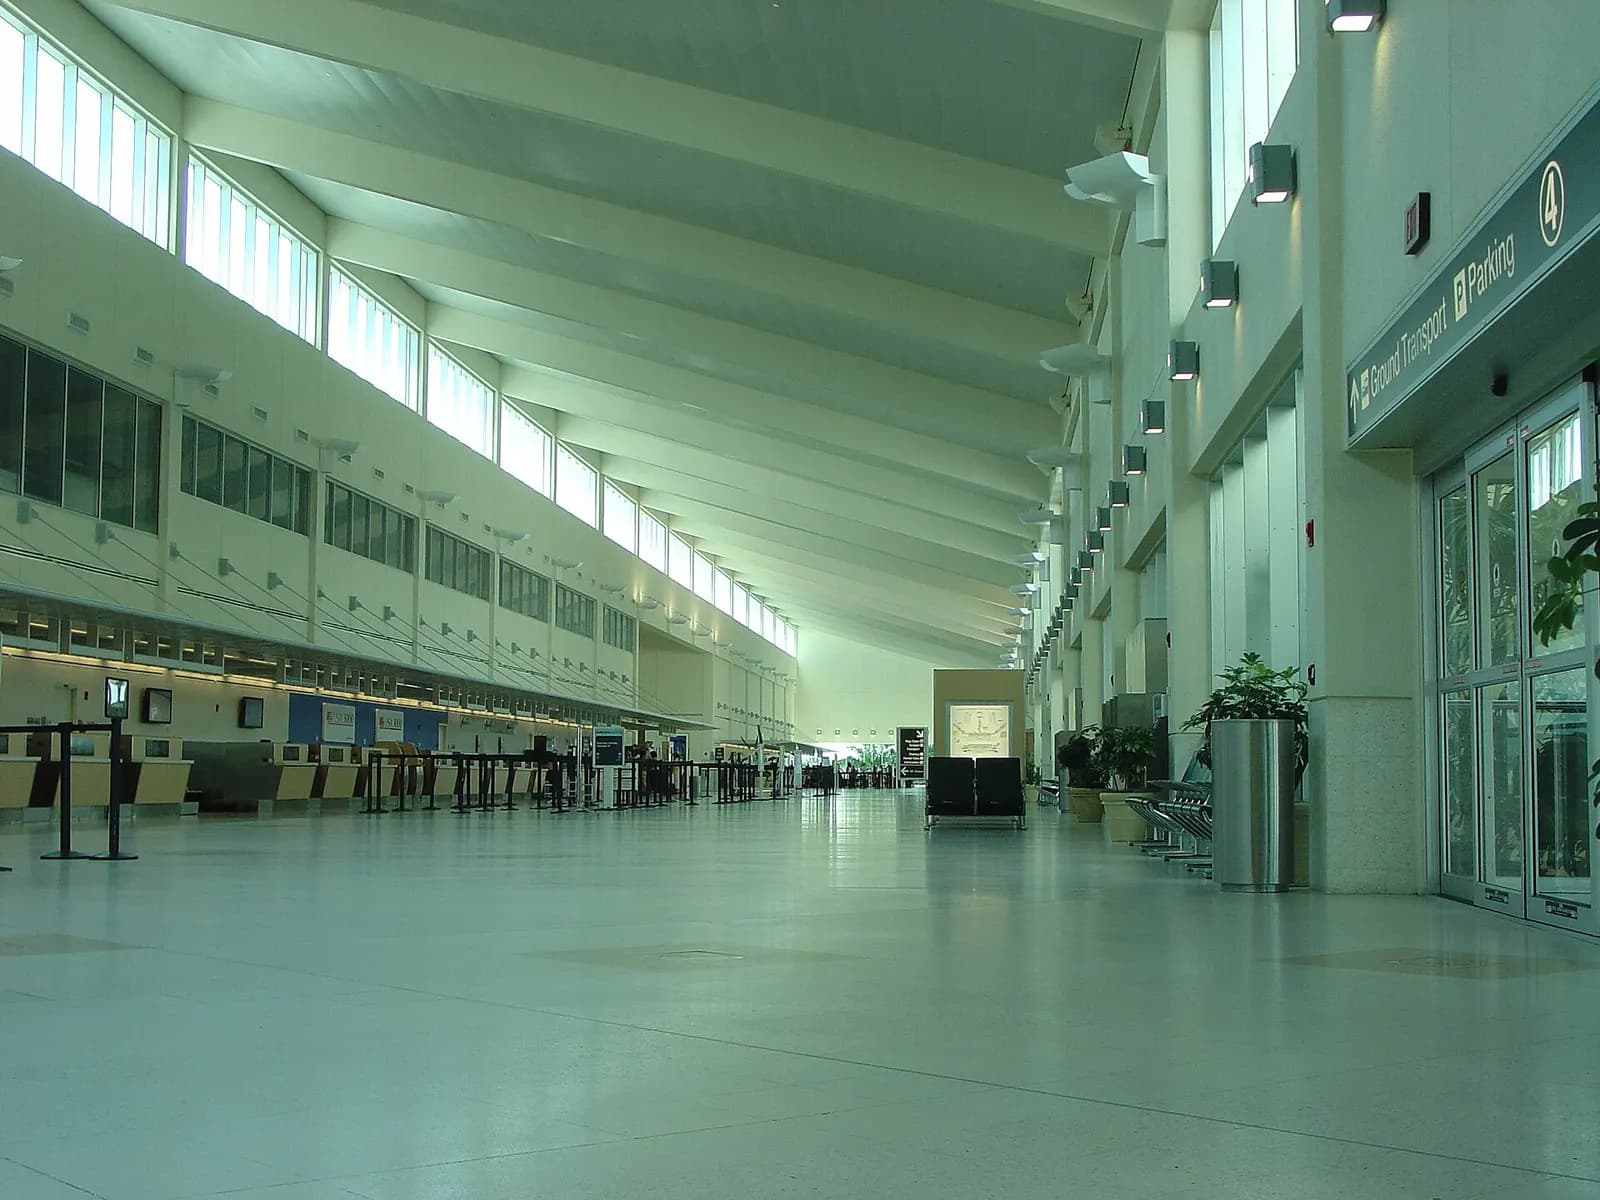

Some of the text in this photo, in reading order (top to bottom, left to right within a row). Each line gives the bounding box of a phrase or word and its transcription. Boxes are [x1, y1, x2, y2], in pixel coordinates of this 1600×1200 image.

[1545, 170, 1558, 231] 4
[1370, 340, 1400, 397] Ground
[1401, 296, 1447, 367] Transport
[1468, 233, 1515, 303] Parking
